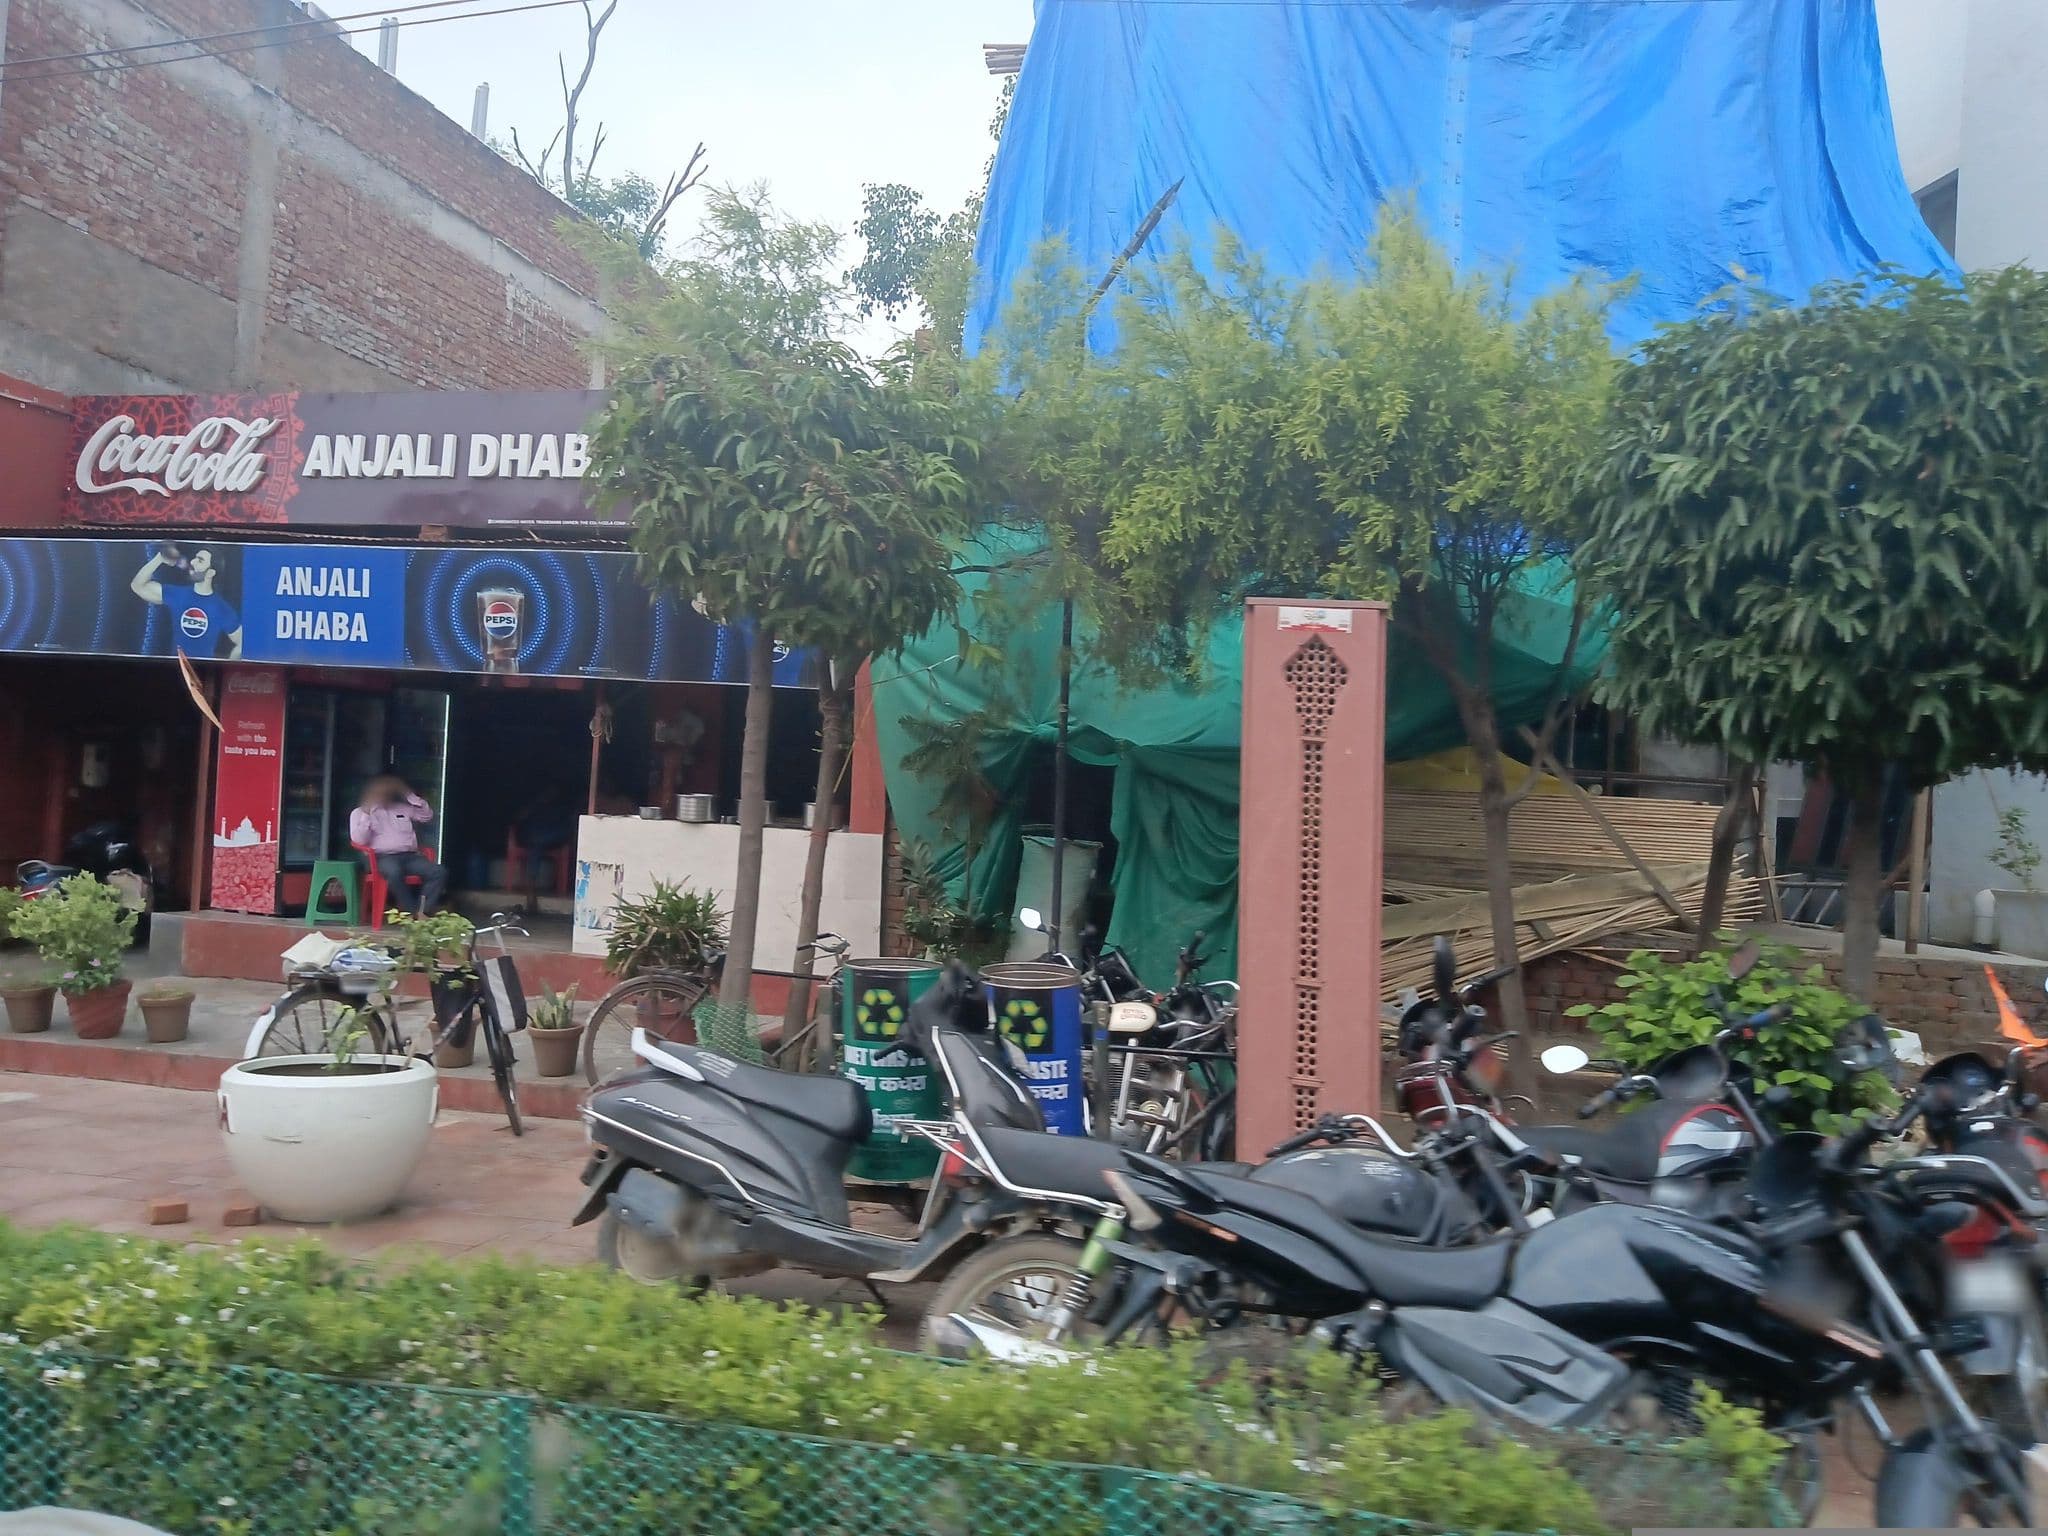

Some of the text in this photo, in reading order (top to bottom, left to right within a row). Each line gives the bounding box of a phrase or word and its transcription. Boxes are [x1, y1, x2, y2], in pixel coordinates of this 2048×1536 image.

[76, 415, 282, 497] Coca-Cola
[302, 433, 625, 479] ANJALI DHAB
[276, 566, 370, 598] ANJALI
[276, 609, 369, 642] DHABA
[485, 615, 516, 625] PEPSI
[245, 747, 259, 756] you
[260, 747, 277, 756] love
